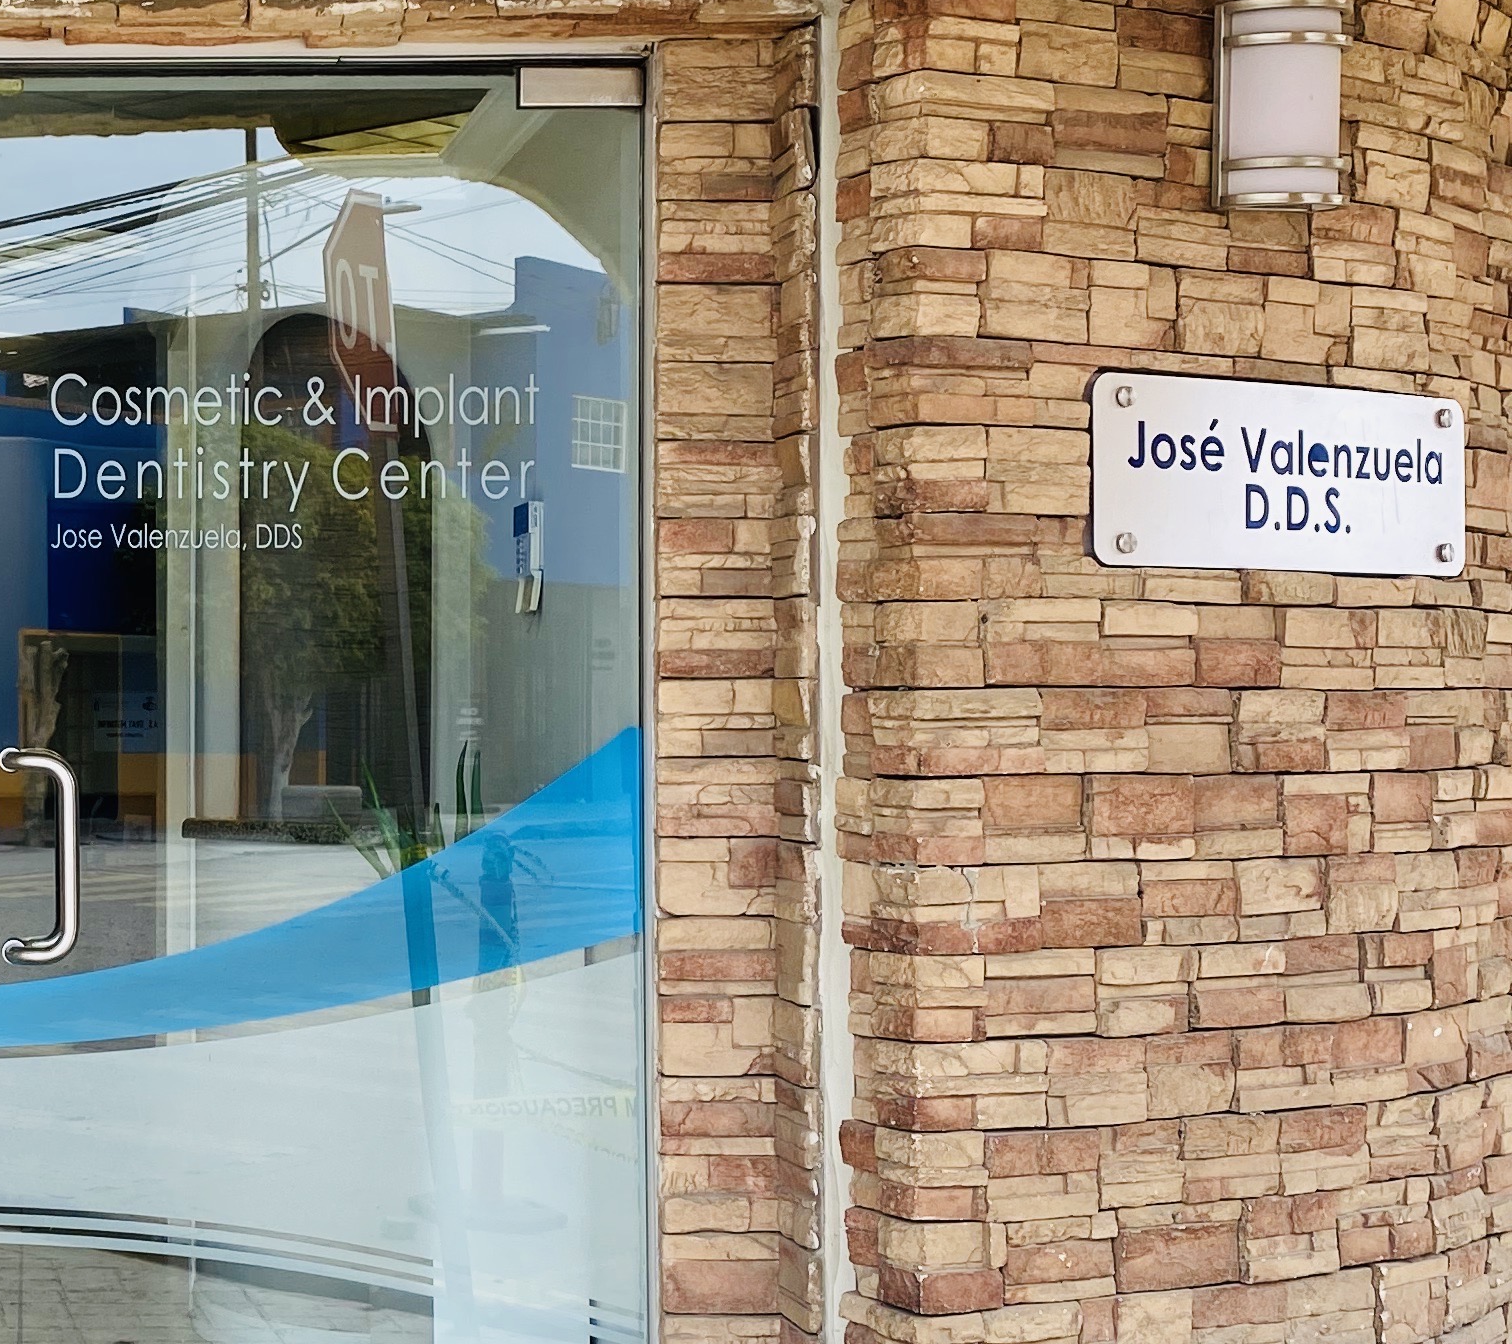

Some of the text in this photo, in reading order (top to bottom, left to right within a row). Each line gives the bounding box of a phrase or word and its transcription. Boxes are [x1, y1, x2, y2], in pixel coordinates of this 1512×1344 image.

[50, 372, 539, 438] Cosmetic & Implant
[54, 447, 535, 511] Dentistry Center
[1127, 418, 1443, 485] José Valenzuela
[51, 522, 303, 552] Jose Valenzuela, DDS
[1245, 483, 1351, 534] D.D.S.
